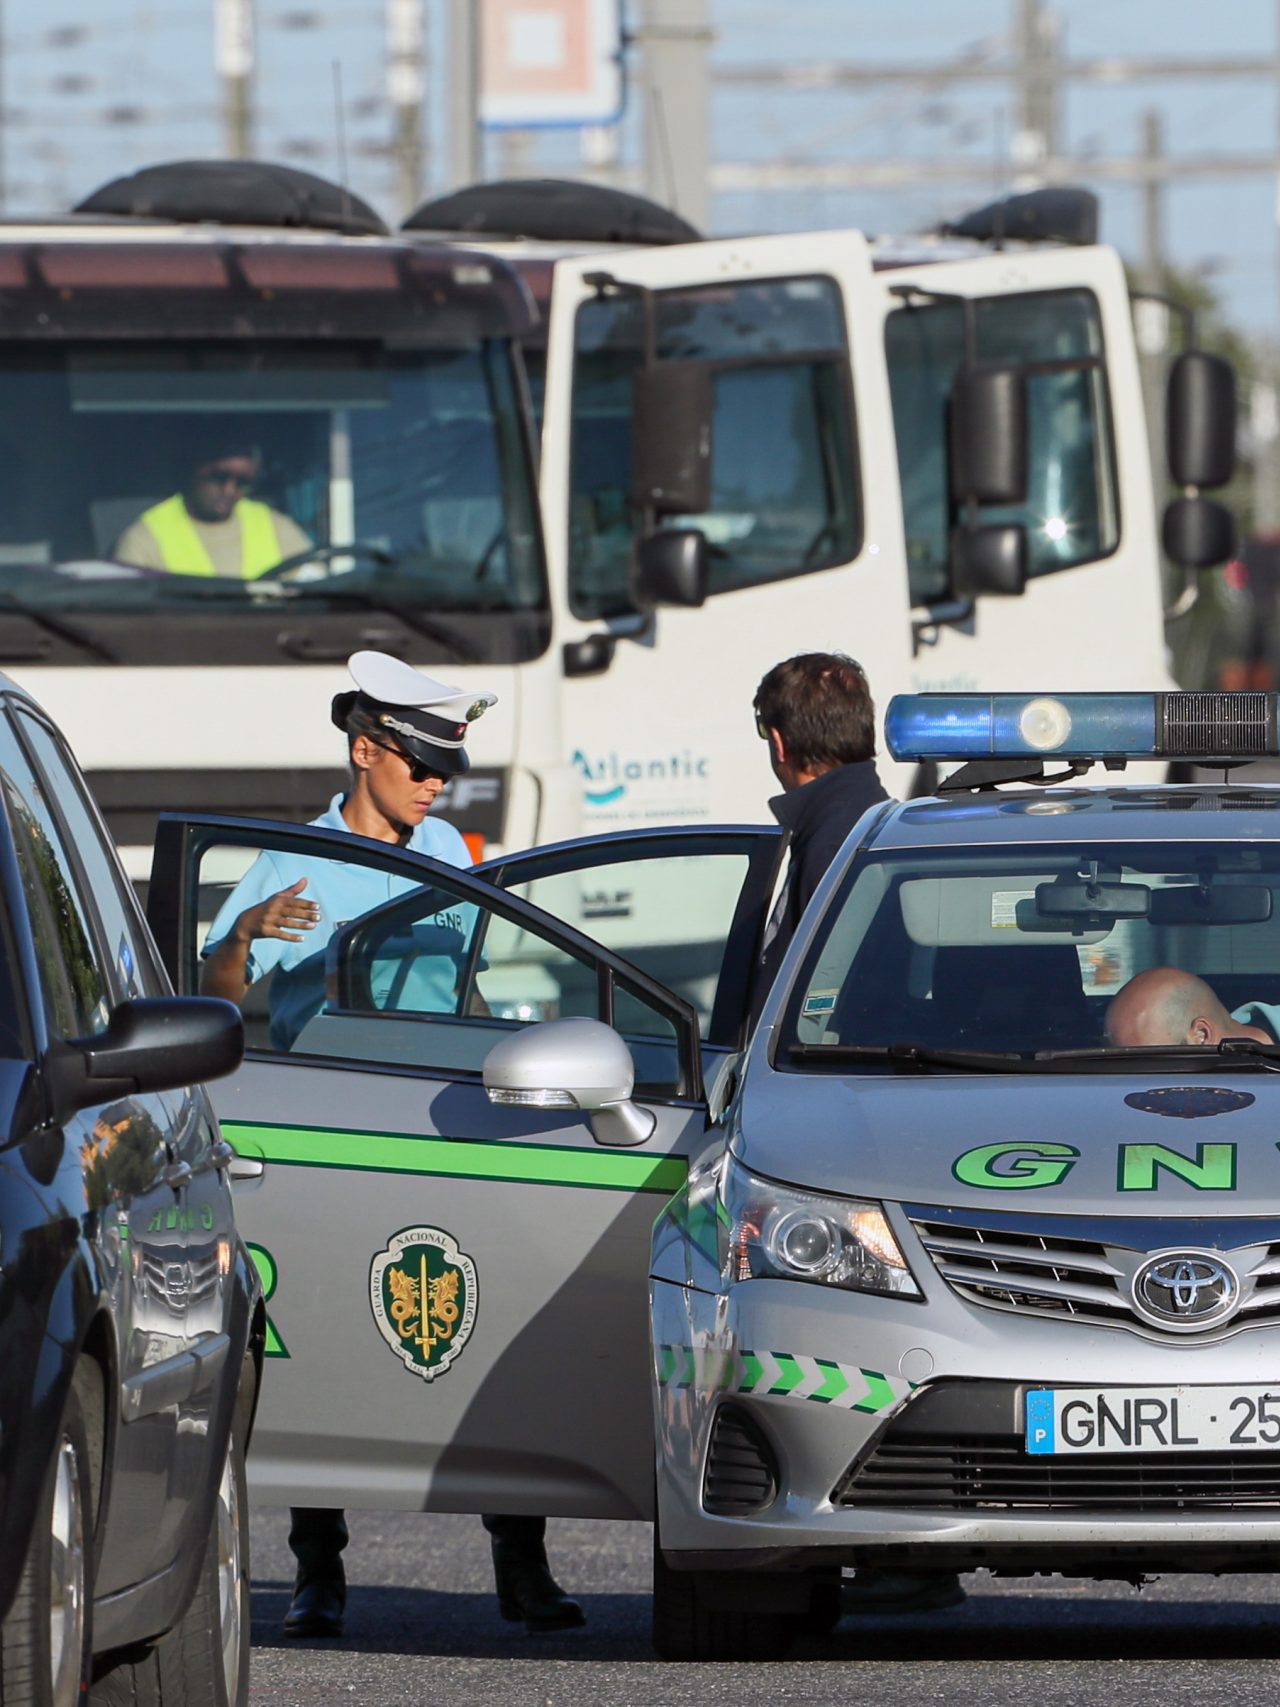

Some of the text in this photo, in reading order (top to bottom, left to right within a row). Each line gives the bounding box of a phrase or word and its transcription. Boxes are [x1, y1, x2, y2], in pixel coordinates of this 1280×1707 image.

[570, 750, 708, 780] Atlantic
[434, 912, 462, 931] GNR
[372, 1232, 476, 1340] GUARDA NACIONAL REPUBLICANA
[1035, 1429, 1047, 1443] P
[1061, 1397, 1199, 1447] GNRL
